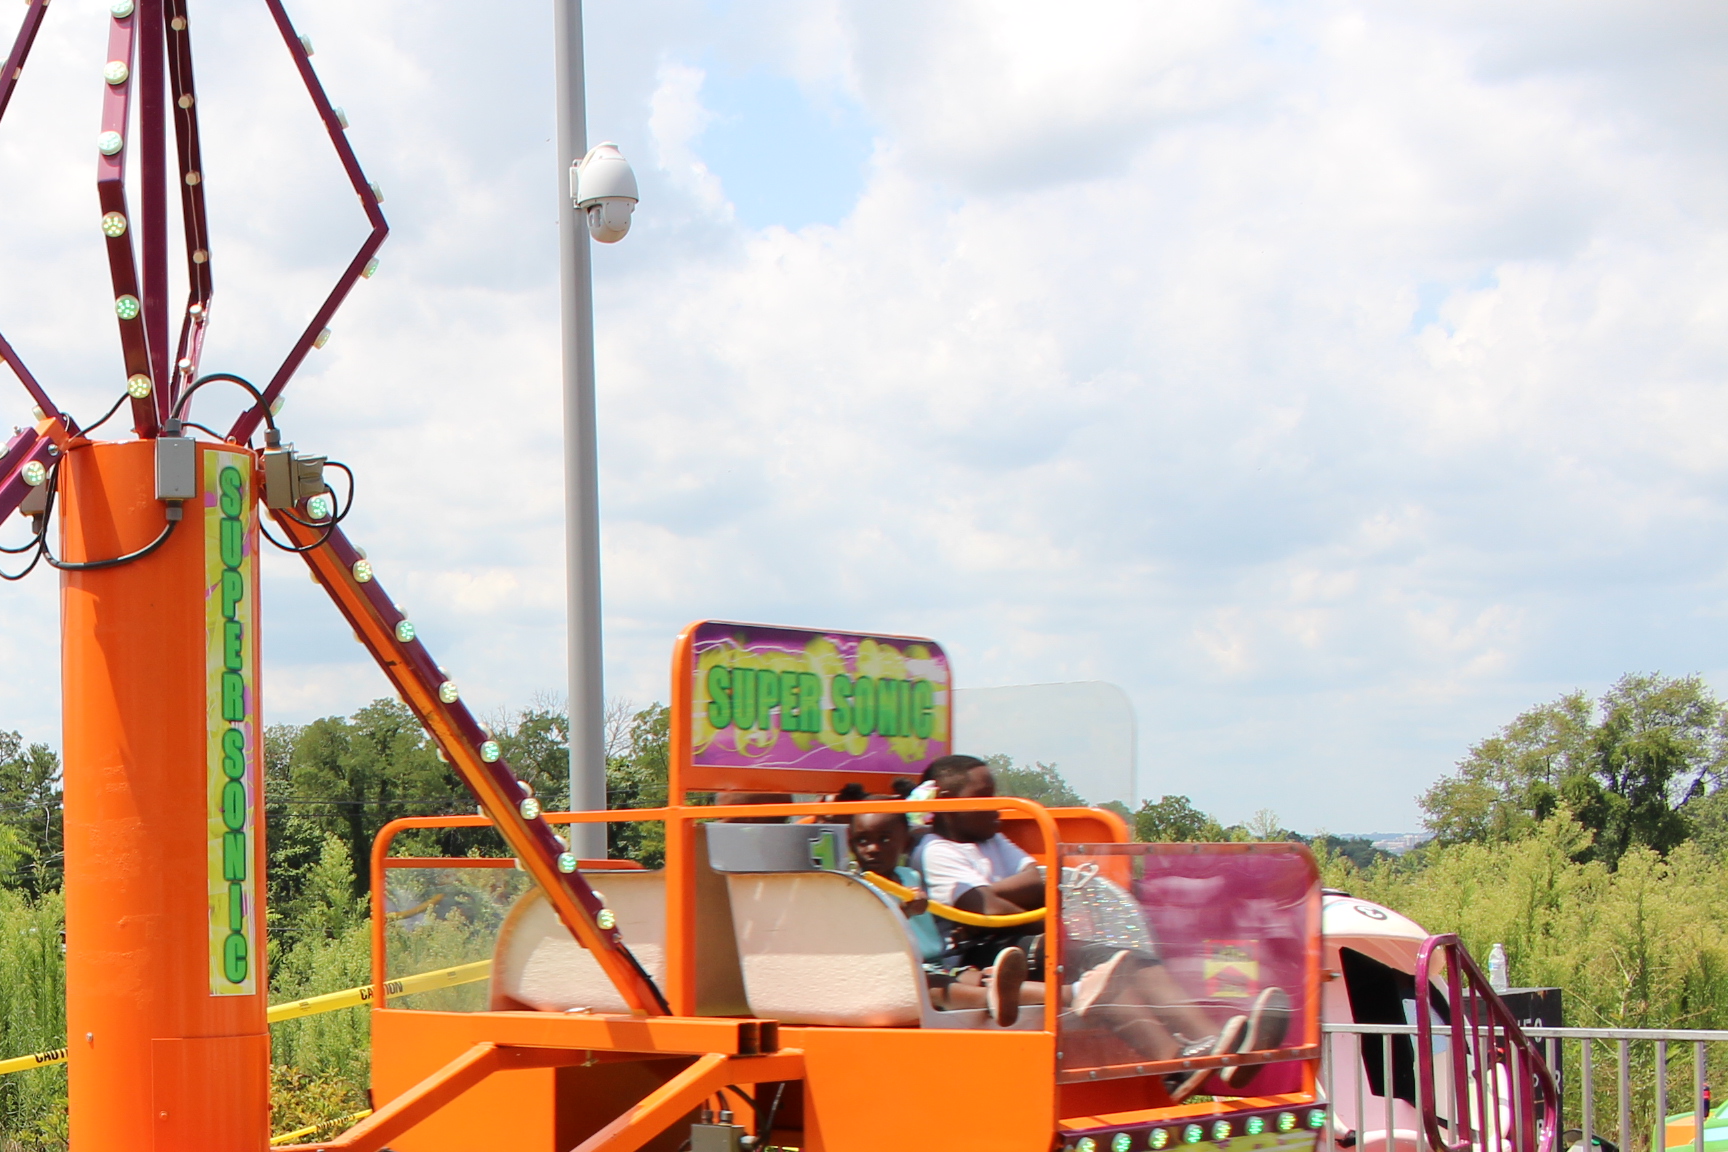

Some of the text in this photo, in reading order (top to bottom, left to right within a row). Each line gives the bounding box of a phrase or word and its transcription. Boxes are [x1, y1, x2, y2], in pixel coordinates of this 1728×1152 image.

[219, 465, 248, 984] SUPER SONIC
[706, 664, 934, 739] SUPER SONIC
[359, 980, 404, 1001] CAION
